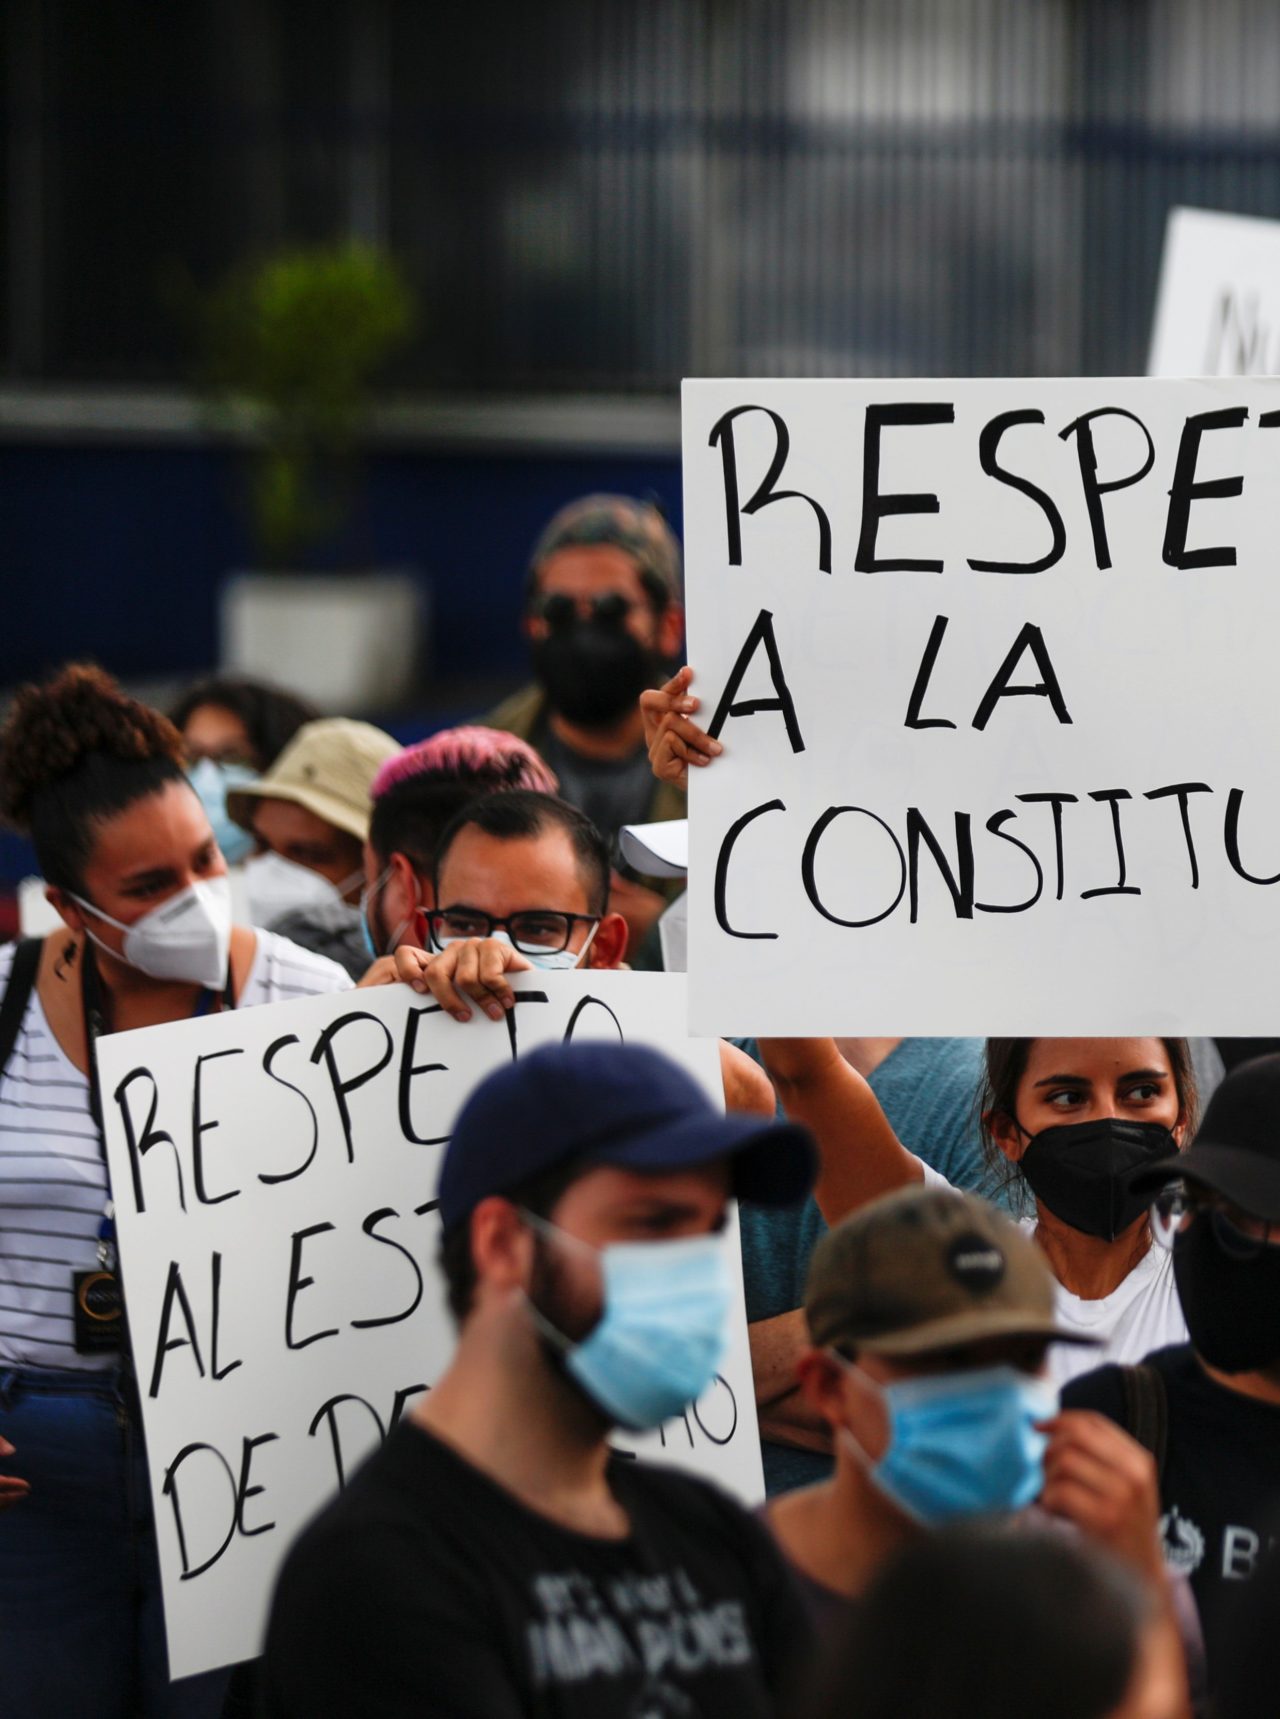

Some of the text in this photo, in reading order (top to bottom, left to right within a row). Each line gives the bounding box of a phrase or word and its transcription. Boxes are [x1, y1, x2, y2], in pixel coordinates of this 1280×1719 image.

[706, 609, 1073, 753] A LA
[113, 991, 624, 1213] RESPE
[150, 1251, 243, 1398] AL
[162, 1432, 280, 1581] DE
